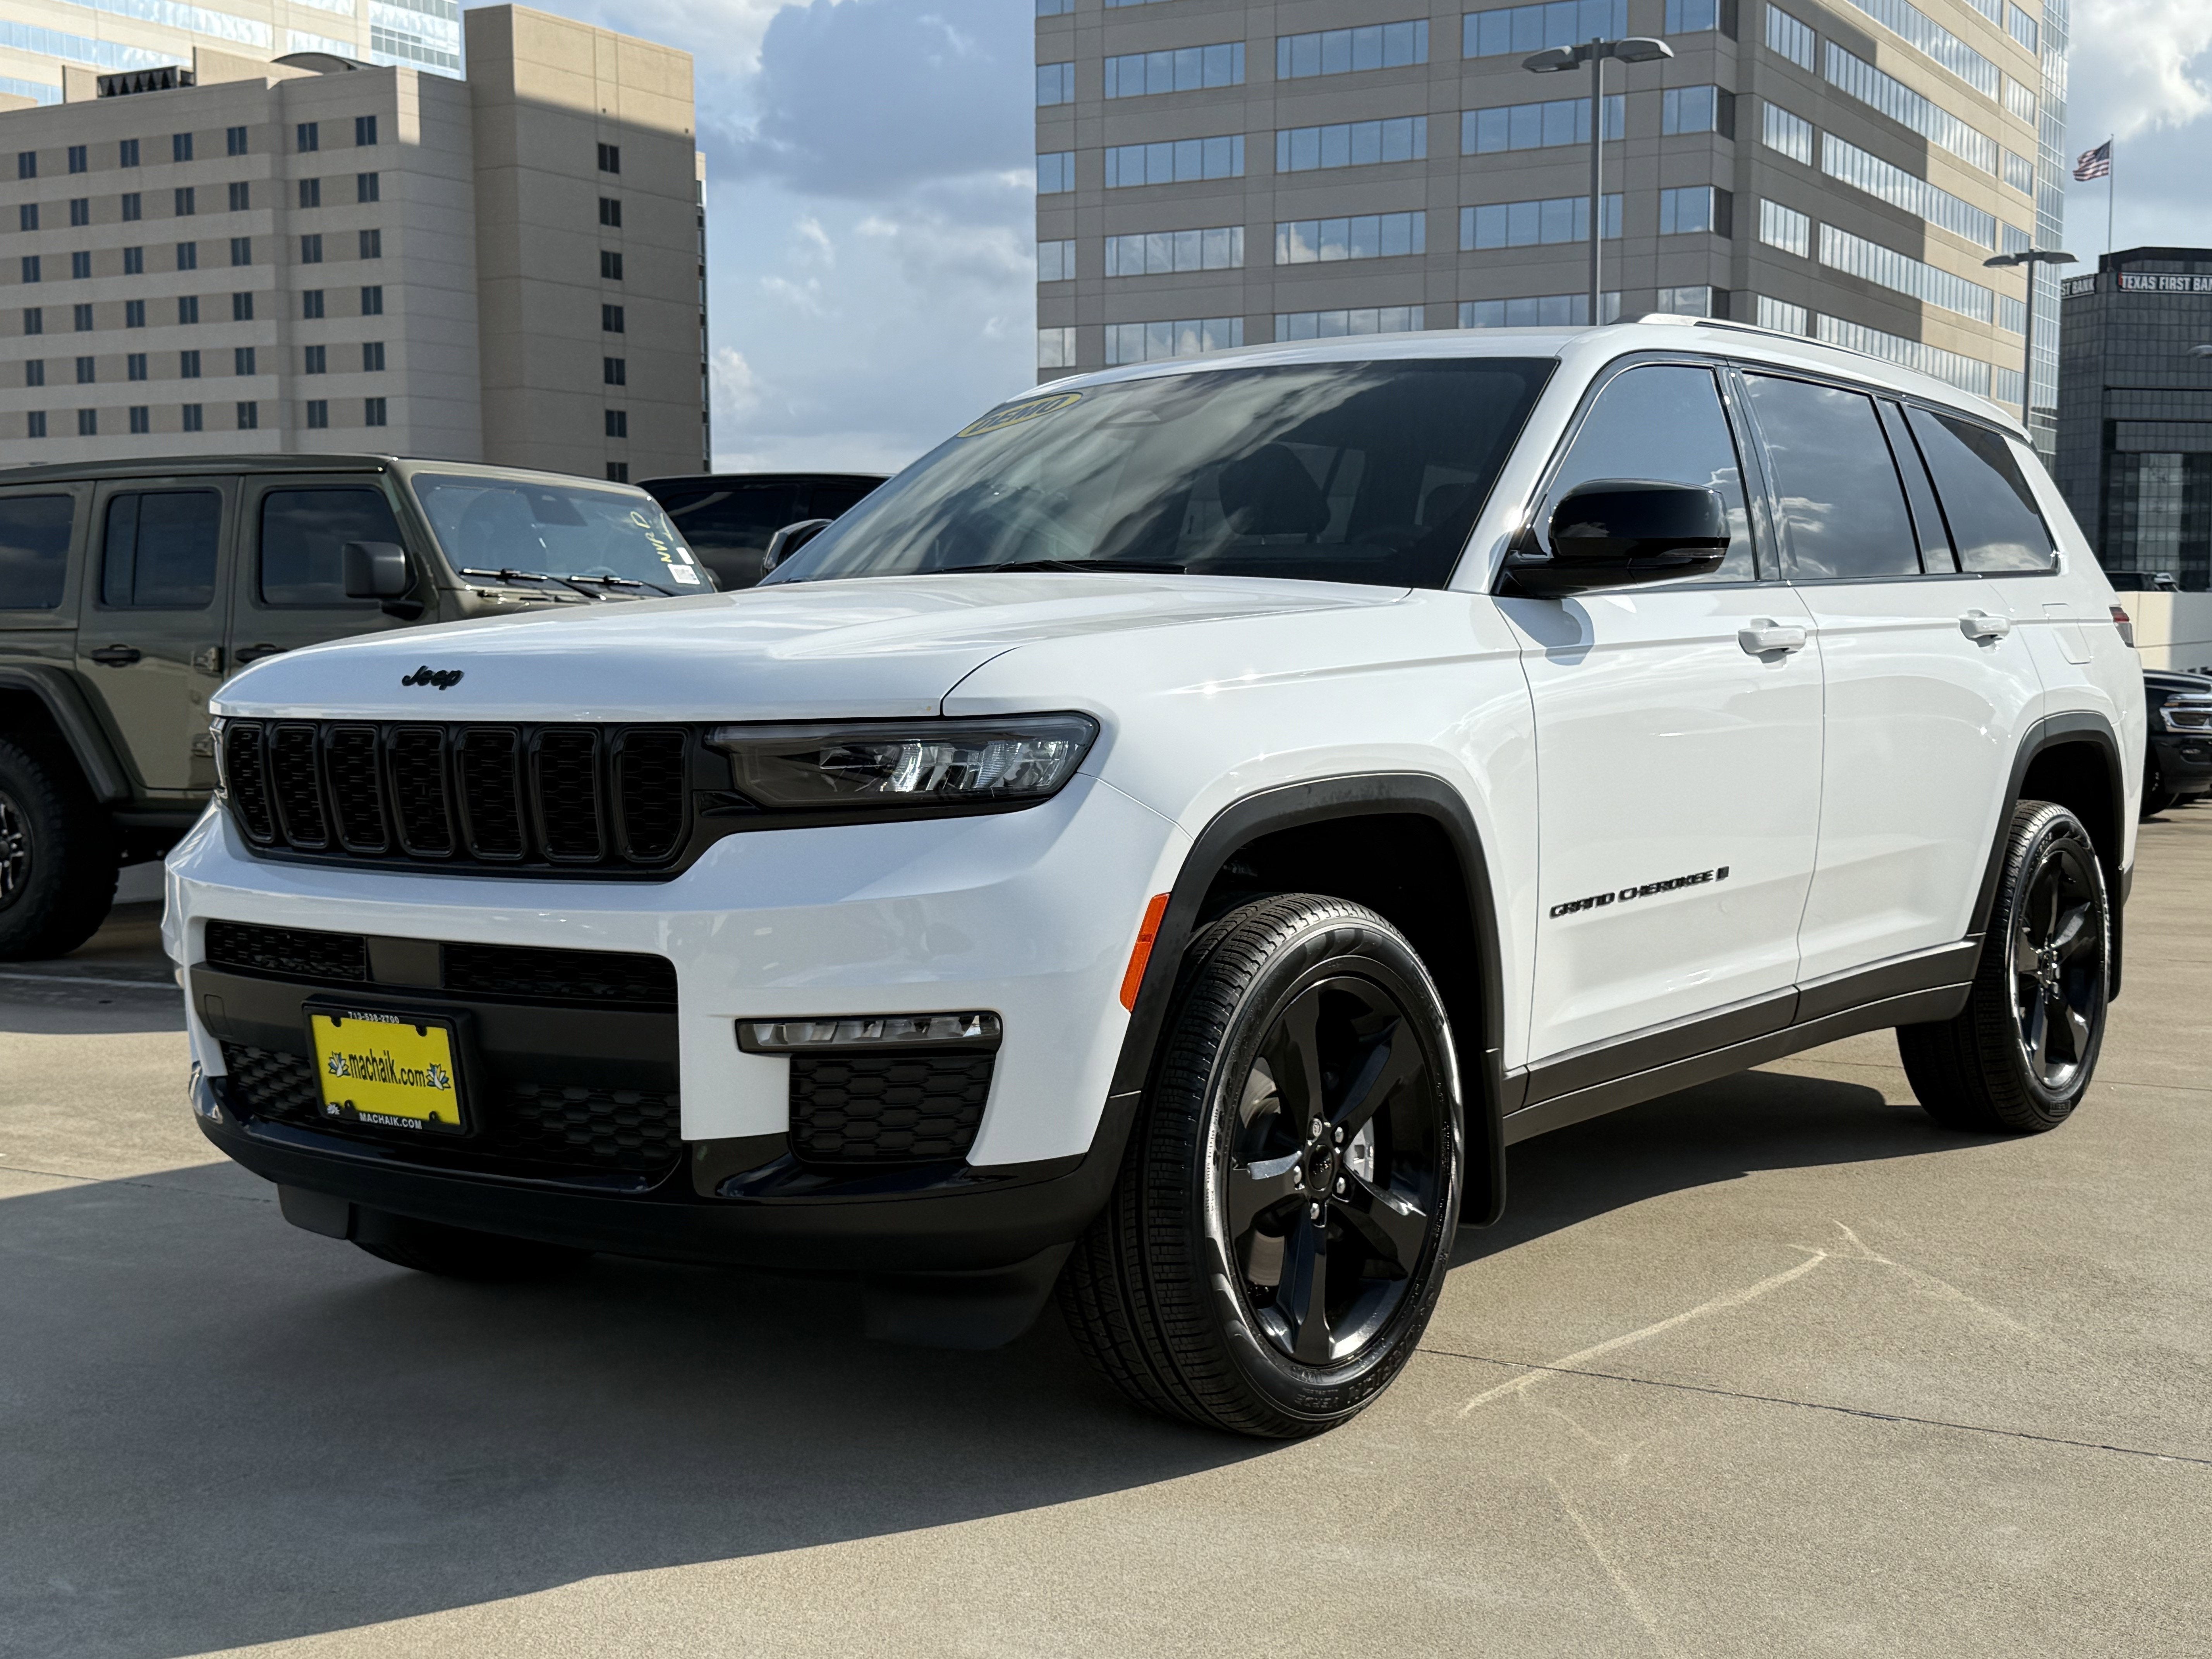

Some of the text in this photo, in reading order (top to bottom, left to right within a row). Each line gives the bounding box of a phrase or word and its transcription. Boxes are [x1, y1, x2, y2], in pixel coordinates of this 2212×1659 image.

[2121, 275, 2157, 290] TEXAS
[2159, 276, 2191, 291] FIRST
[967, 396, 1070, 435] DEMO
[402, 665, 464, 690] Jeep
[1549, 892, 1615, 919] GRAND
[1618, 869, 1714, 903] CHEROKEE
[348, 1048, 426, 1087] machaik.com
[359, 1112, 422, 1130] MACHAIK.COM
